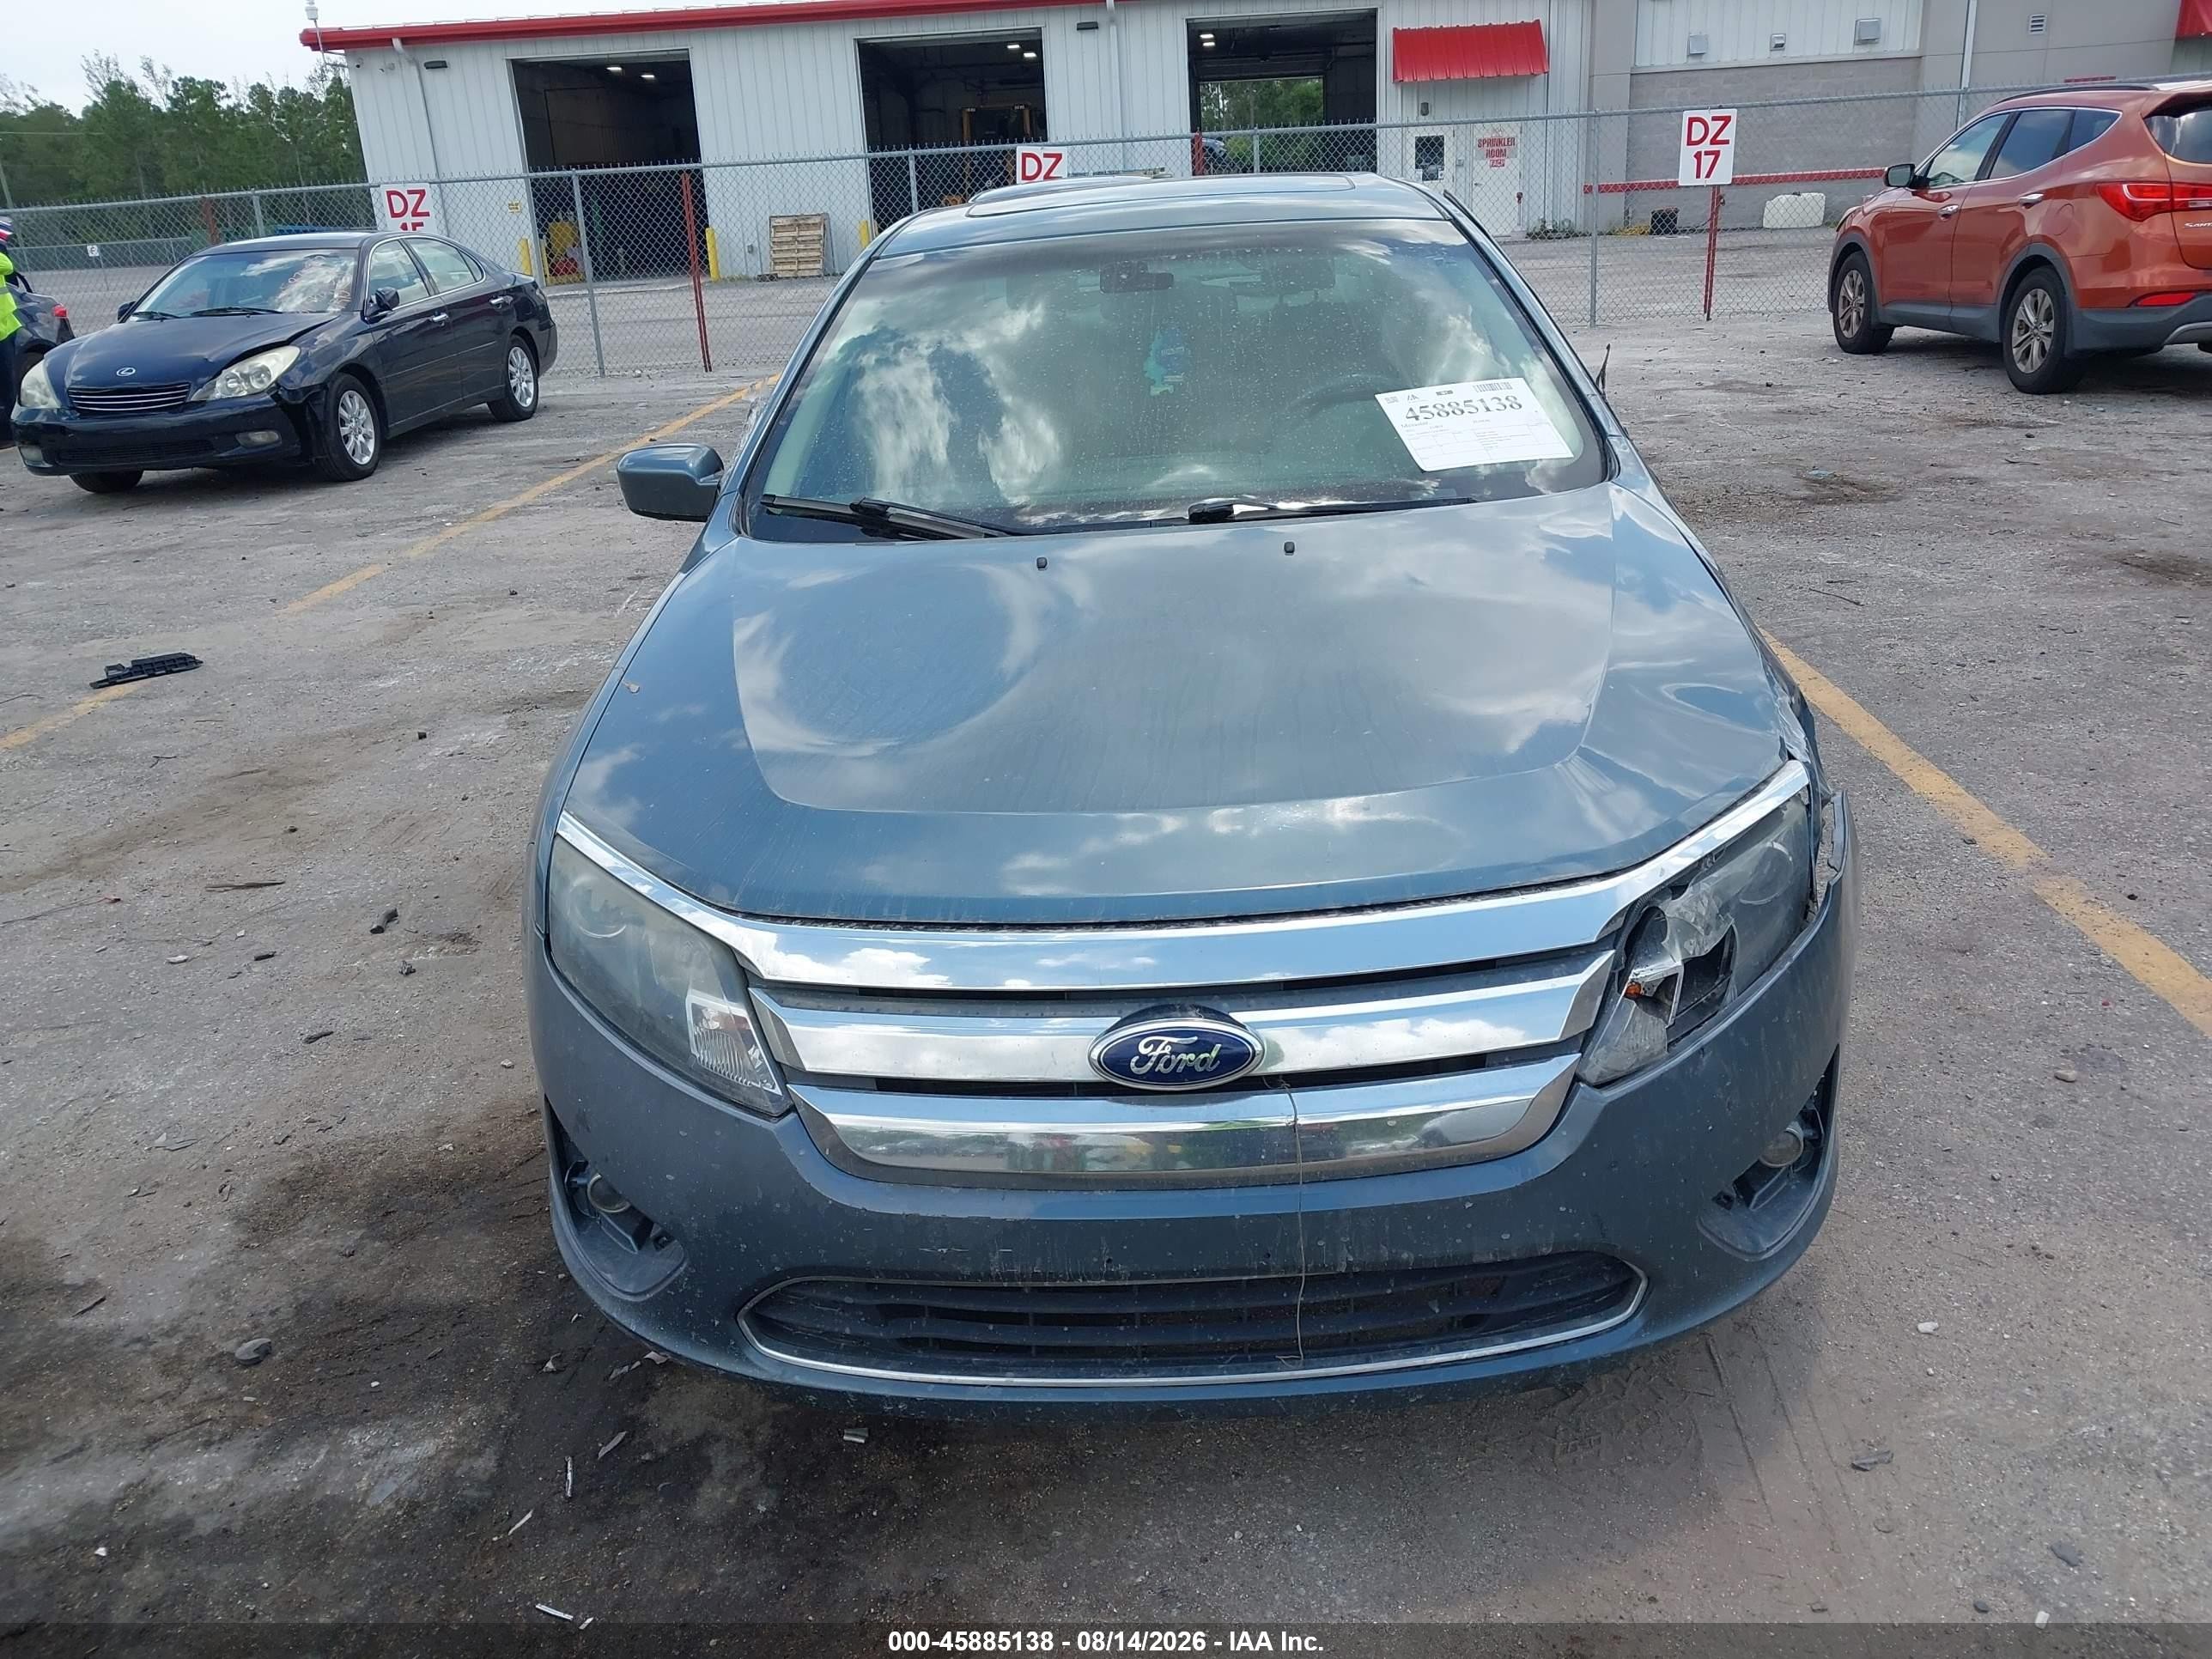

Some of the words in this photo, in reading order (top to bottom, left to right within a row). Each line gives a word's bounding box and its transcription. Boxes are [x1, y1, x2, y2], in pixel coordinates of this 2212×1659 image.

[1478, 137, 1516, 148] SPRINKLER
[1686, 115, 1732, 146] DZ
[1021, 152, 1063, 181] DZ
[1486, 149, 1506, 158] ROOM
[1693, 149, 1721, 179] 17
[386, 189, 430, 218] DZ
[1405, 395, 1522, 421] 45885138
[1130, 1036, 1222, 1074] Ford
